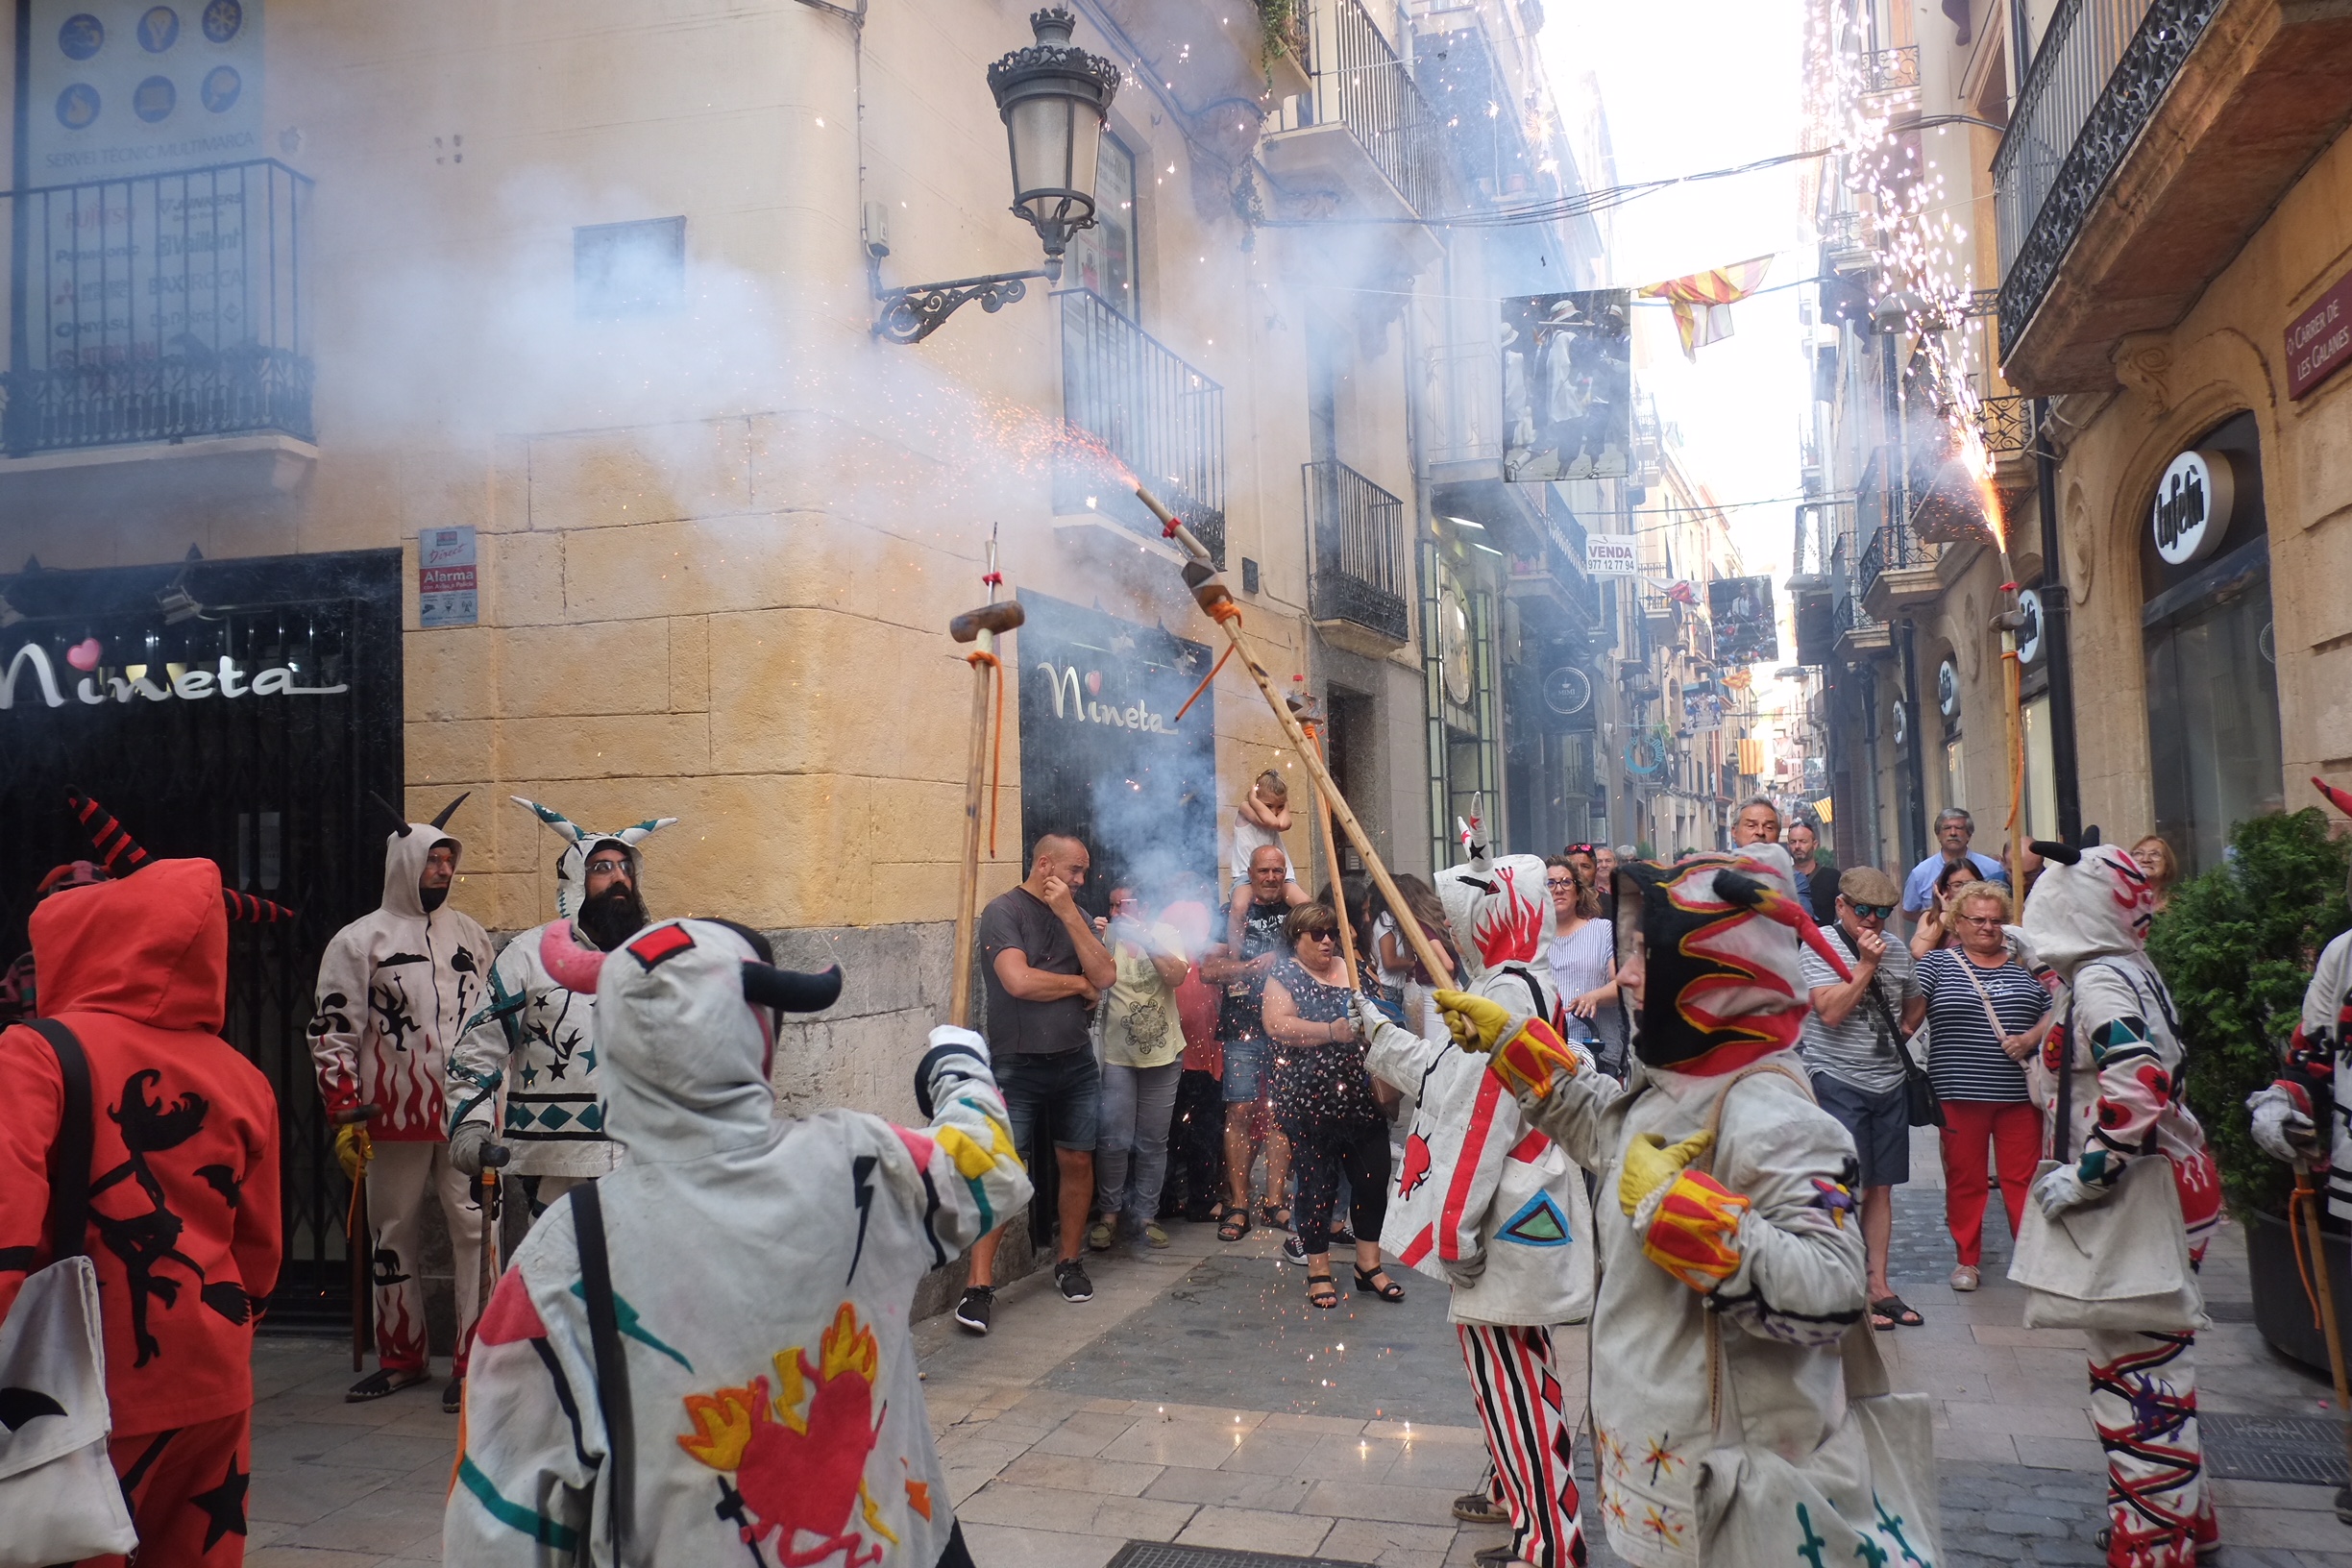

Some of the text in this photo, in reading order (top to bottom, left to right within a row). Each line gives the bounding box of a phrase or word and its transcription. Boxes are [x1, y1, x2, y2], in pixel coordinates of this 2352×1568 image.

[46, 151, 97, 169] SERVEI
[158, 132, 255, 159] MULTIMARCA
[2294, 299, 2340, 349] CARRER DE
[2297, 326, 2350, 381] LES GALANES
[429, 544, 467, 563] Direct
[1588, 546, 1632, 559] VENDA
[1588, 559, 1634, 571] 977 12 77 94
[424, 570, 474, 583] Alarma
[1038, 662, 1179, 735] Nineta
